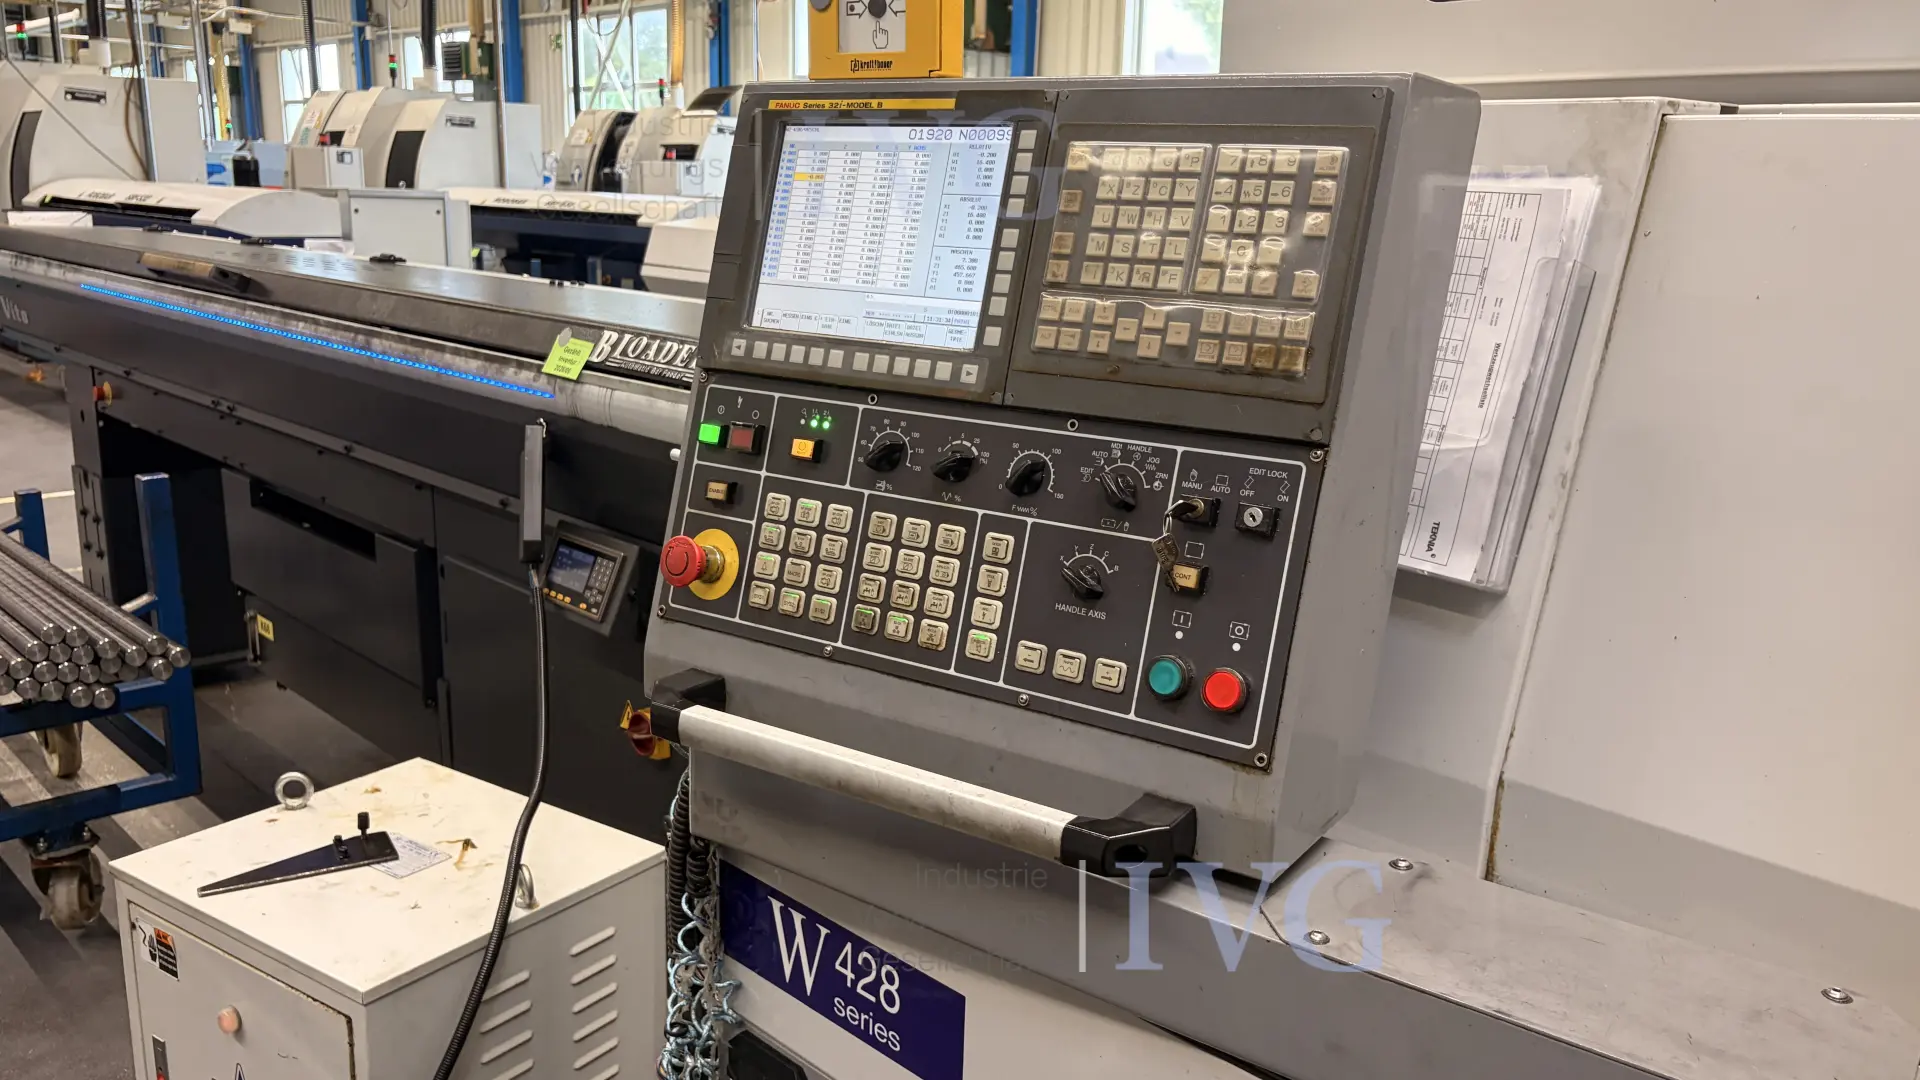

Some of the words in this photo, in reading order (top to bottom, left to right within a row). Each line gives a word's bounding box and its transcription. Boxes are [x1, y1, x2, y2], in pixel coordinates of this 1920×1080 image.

[1163, 157, 1172, 167] G
[1190, 156, 1200, 167] P
[1231, 156, 1239, 166] 7
[1258, 156, 1267, 166] 8
[1287, 156, 1297, 166] 9
[1106, 185, 1116, 195] X
[1131, 185, 1141, 196] Z
[1159, 185, 1168, 196] C
[1186, 185, 1195, 196] Y
[1224, 185, 1233, 196] 4
[1252, 186, 1262, 196] 5
[1281, 186, 1291, 197] 6
[1102, 214, 1111, 223] U
[1127, 213, 1137, 225] W
[1153, 215, 1162, 225] H
[1180, 216, 1190, 226] V
[1220, 215, 1226, 225] 1
[1246, 215, 1257, 227] 2
[1275, 217, 1285, 228] 3
[1095, 241, 1105, 251] M
[1121, 242, 1130, 253] S
[1149, 243, 1157, 254] T
[1174, 245, 1182, 255] L
[1116, 271, 1124, 282] K
[1168, 273, 1177, 284] F
[1111, 442, 1123, 450] MDI
[1127, 444, 1153, 454] HANDLE
[1091, 450, 1109, 458] AUTO
[1146, 456, 1161, 464] JOG
[1249, 467, 1267, 476] EDIT
[1267, 470, 1288, 479] LOCK
[1181, 481, 1203, 490] MANU
[1210, 485, 1231, 494] AUTO
[1239, 489, 1255, 497] OFF
[1277, 494, 1289, 503] ON
[1425, 521, 1441, 552] TEKNIA
[1174, 572, 1192, 581] CONT
[1055, 602, 1087, 616] HANDLE
[1088, 609, 1107, 620] AXIS
[767, 896, 831, 997] W
[834, 941, 900, 1015] 428
[833, 996, 900, 1052] series
